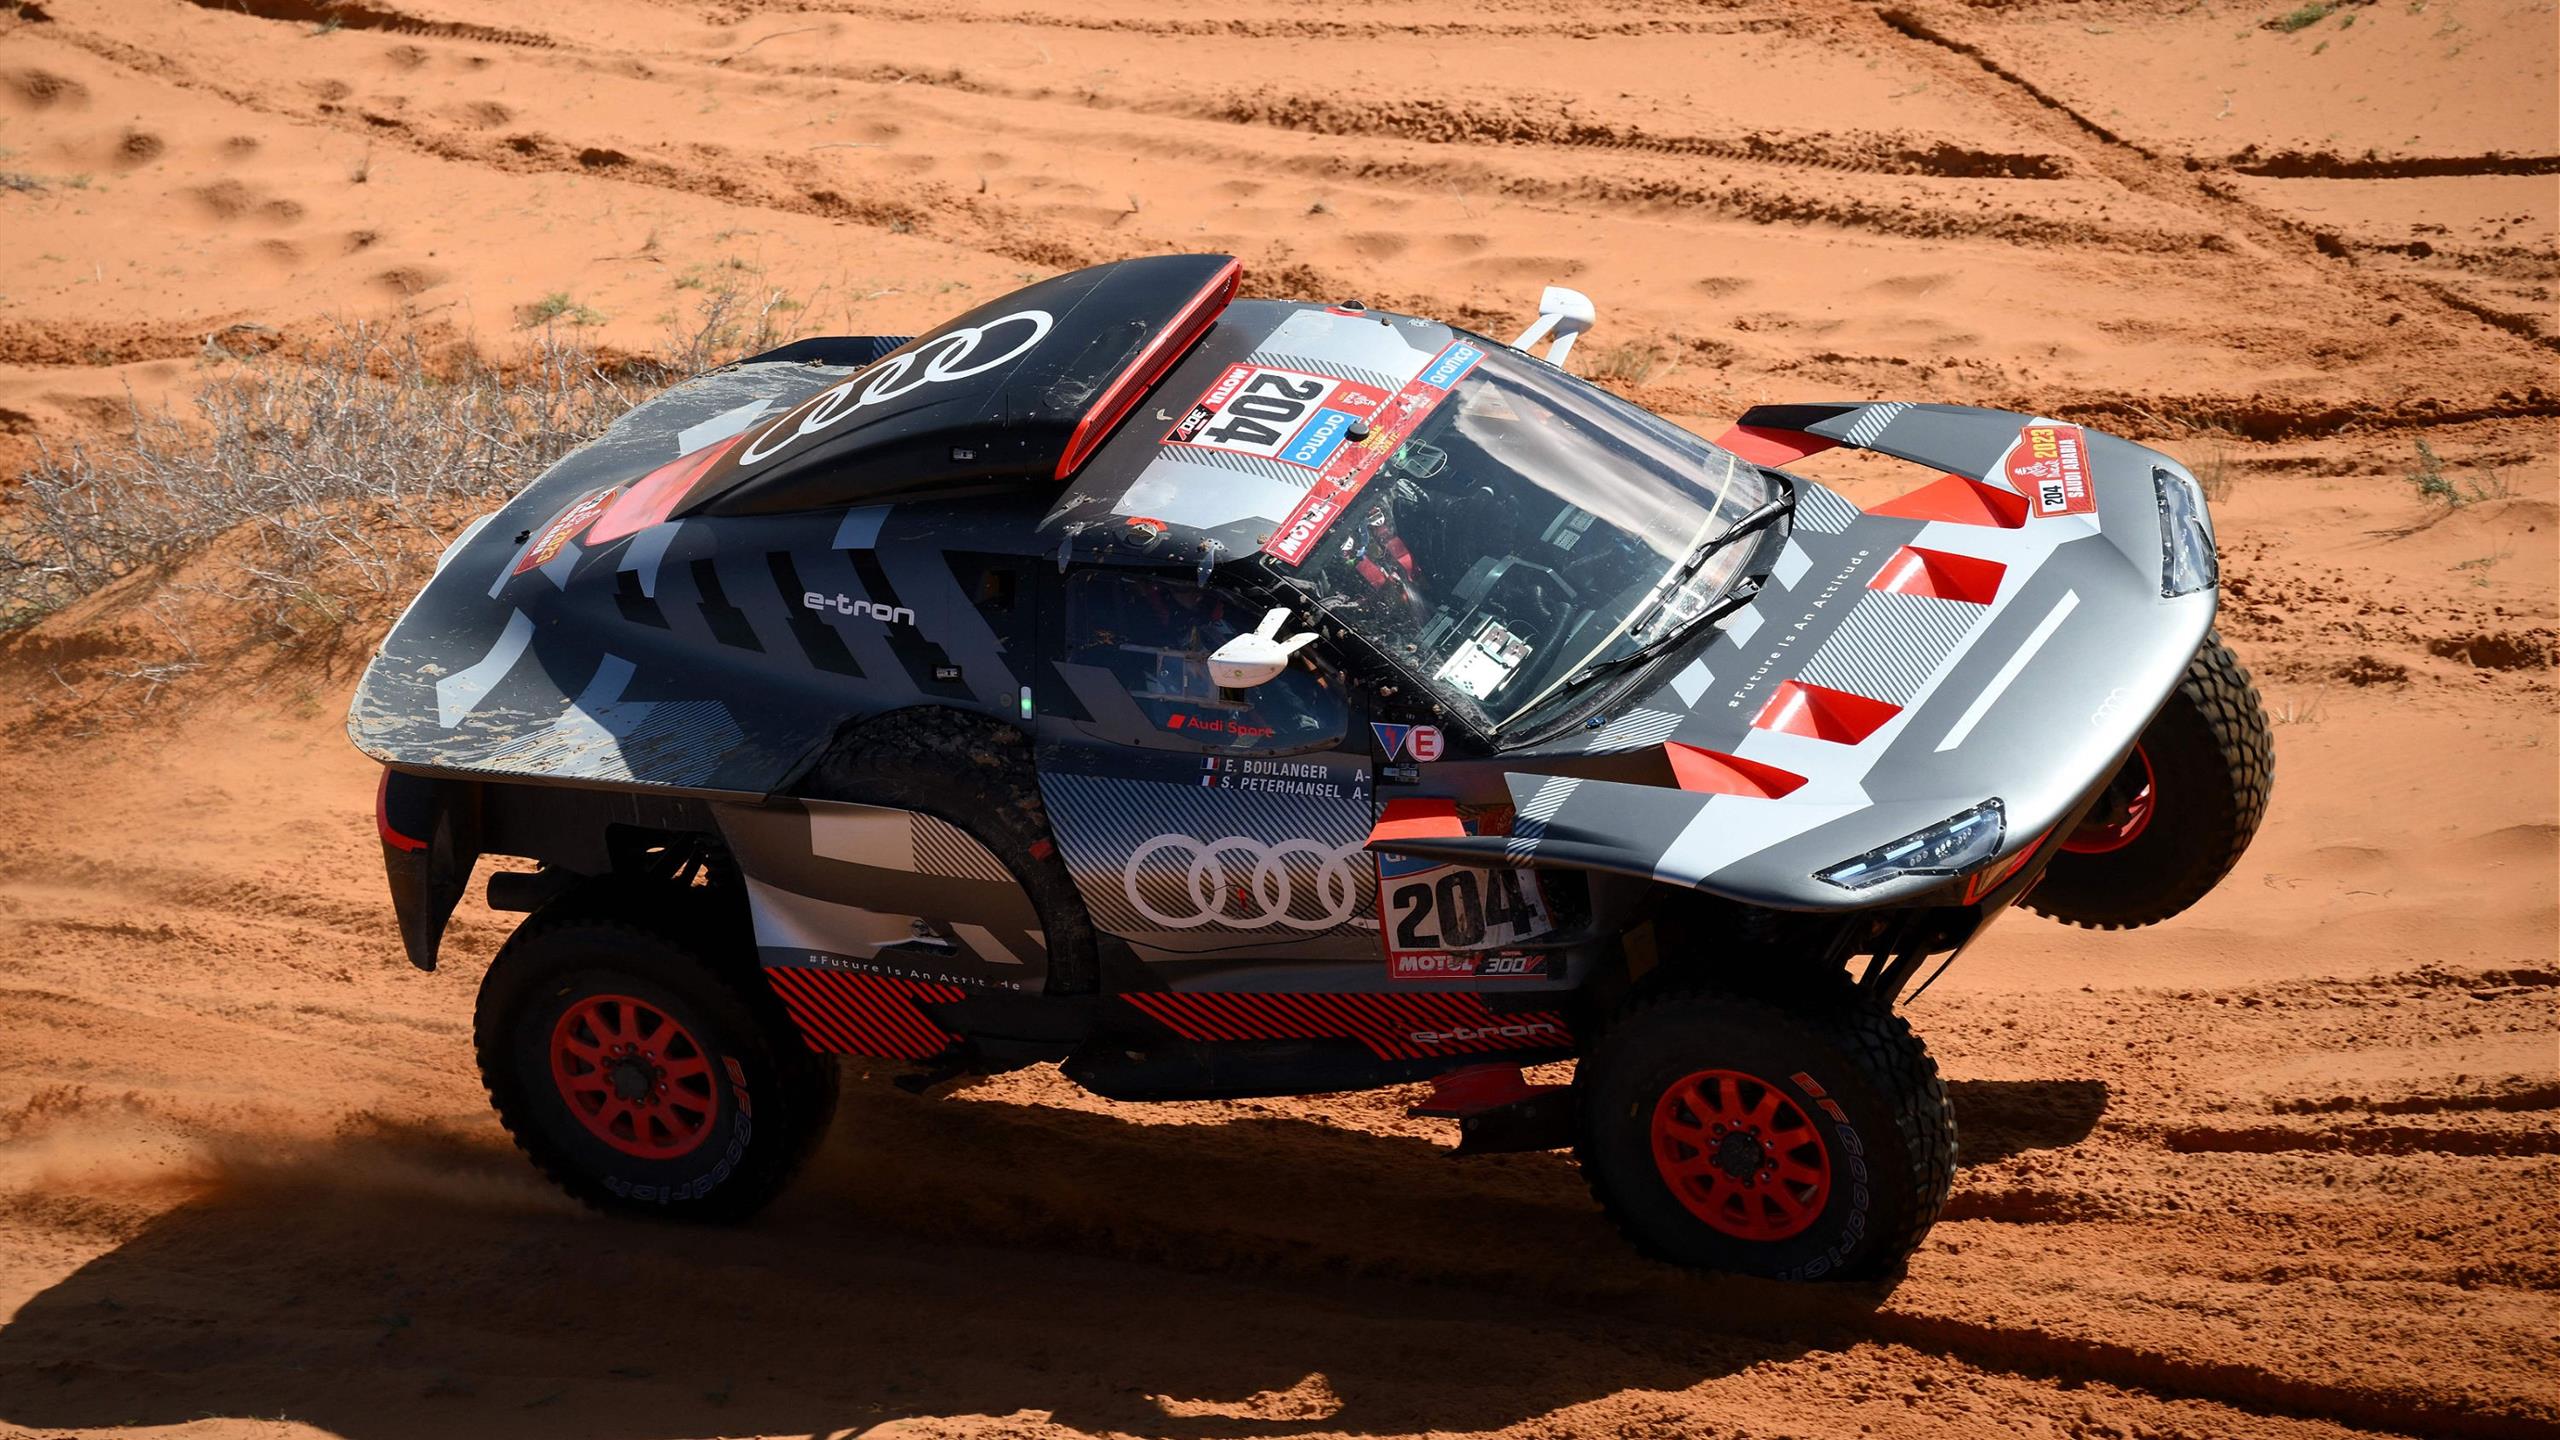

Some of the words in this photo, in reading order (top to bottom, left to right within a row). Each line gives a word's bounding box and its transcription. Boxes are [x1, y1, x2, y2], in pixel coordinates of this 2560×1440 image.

[1430, 347, 1474, 384] aramco
[1205, 368, 1250, 407] MOTUL
[1176, 408, 1207, 441] 300V
[1204, 372, 1325, 447] 204
[1295, 414, 1345, 461] aramco
[2030, 428, 2060, 459] 2023
[2058, 438, 2081, 471] ARABIA
[2042, 484, 2064, 506] 204
[2063, 471, 2085, 498] SAUDI
[1278, 502, 1332, 557] MOTUL
[803, 591, 915, 626] e-tron
[1728, 651, 1782, 708] #Future
[1778, 634, 1796, 648] Is
[1794, 613, 1816, 631] An
[1812, 549, 1870, 609] Attitude
[1187, 715, 1223, 731] Audi
[1227, 720, 1276, 739] Sport
[1414, 729, 1437, 757] E
[1224, 759, 1238, 773] E.
[1243, 760, 1328, 780] BOULANGER
[1354, 768, 1371, 783] A-
[1220, 776, 1234, 790] S.
[1240, 777, 1342, 799] PETERHANSEL
[1352, 786, 1369, 801] A-
[1393, 868, 1539, 949] 204
[809, 954, 880, 973] #Future
[887, 965, 901, 976] Is
[910, 968, 931, 980] An
[1399, 955, 1474, 972] MOTUL
[1485, 955, 1546, 974] 300V
[1410, 1022, 1557, 1044] e-tron
[602, 1055, 752, 1204] BFGoodrich
